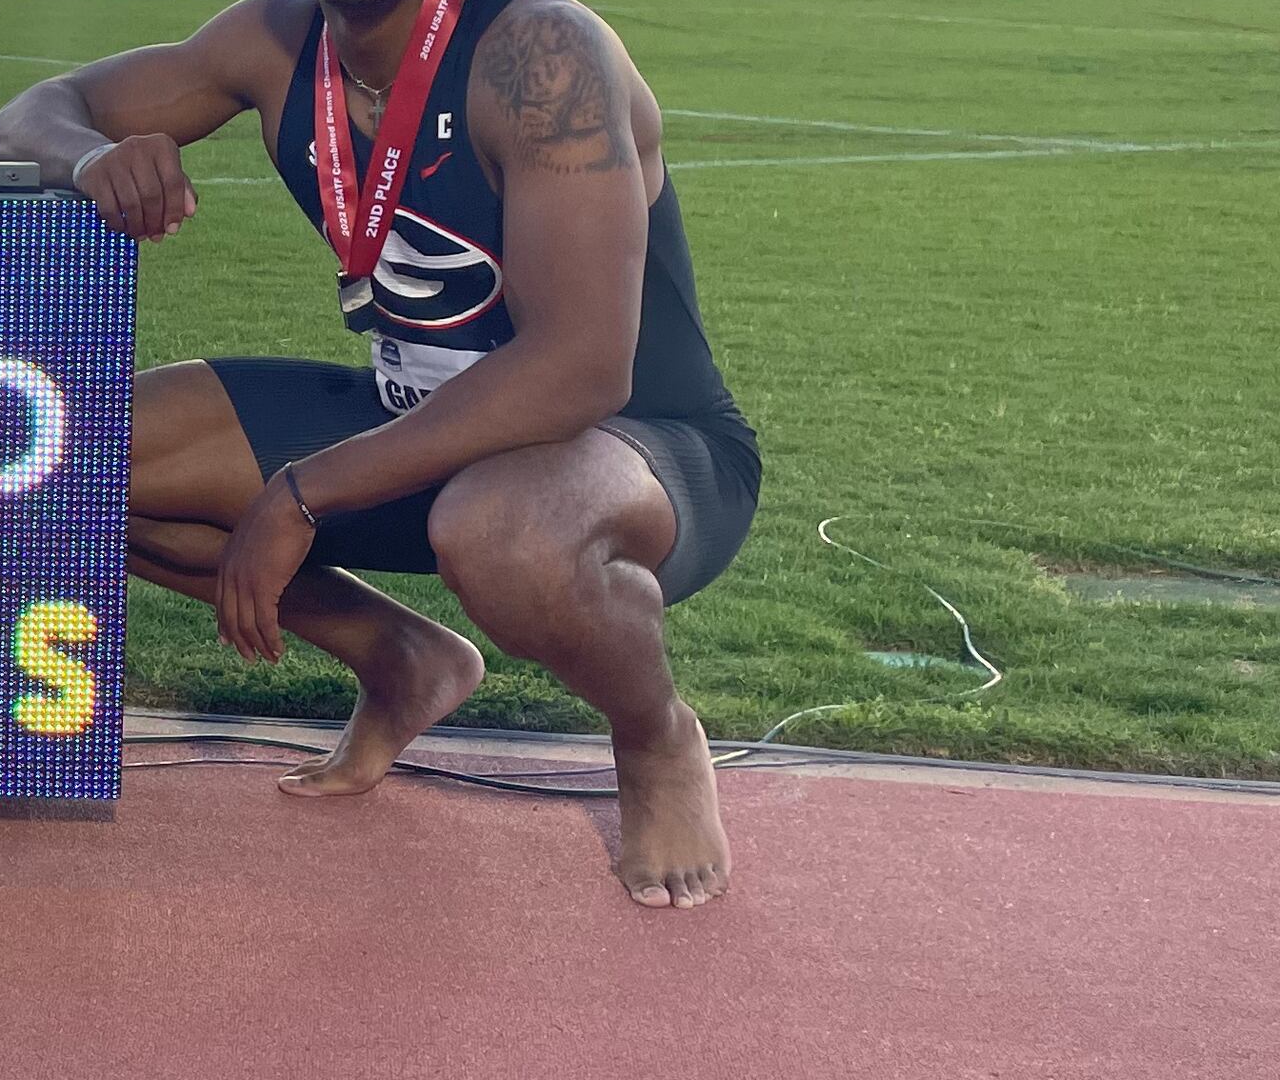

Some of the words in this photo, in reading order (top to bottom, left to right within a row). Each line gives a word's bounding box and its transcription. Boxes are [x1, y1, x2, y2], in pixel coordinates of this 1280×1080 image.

[419, 32, 436, 61] 2022
[326, 90, 335, 124] Events
[437, 112, 453, 139] C
[329, 125, 341, 176] Combined
[332, 177, 345, 209] USATF
[365, 203, 384, 239] 2ND
[375, 146, 401, 201] PLACE
[338, 211, 350, 237] 2022
